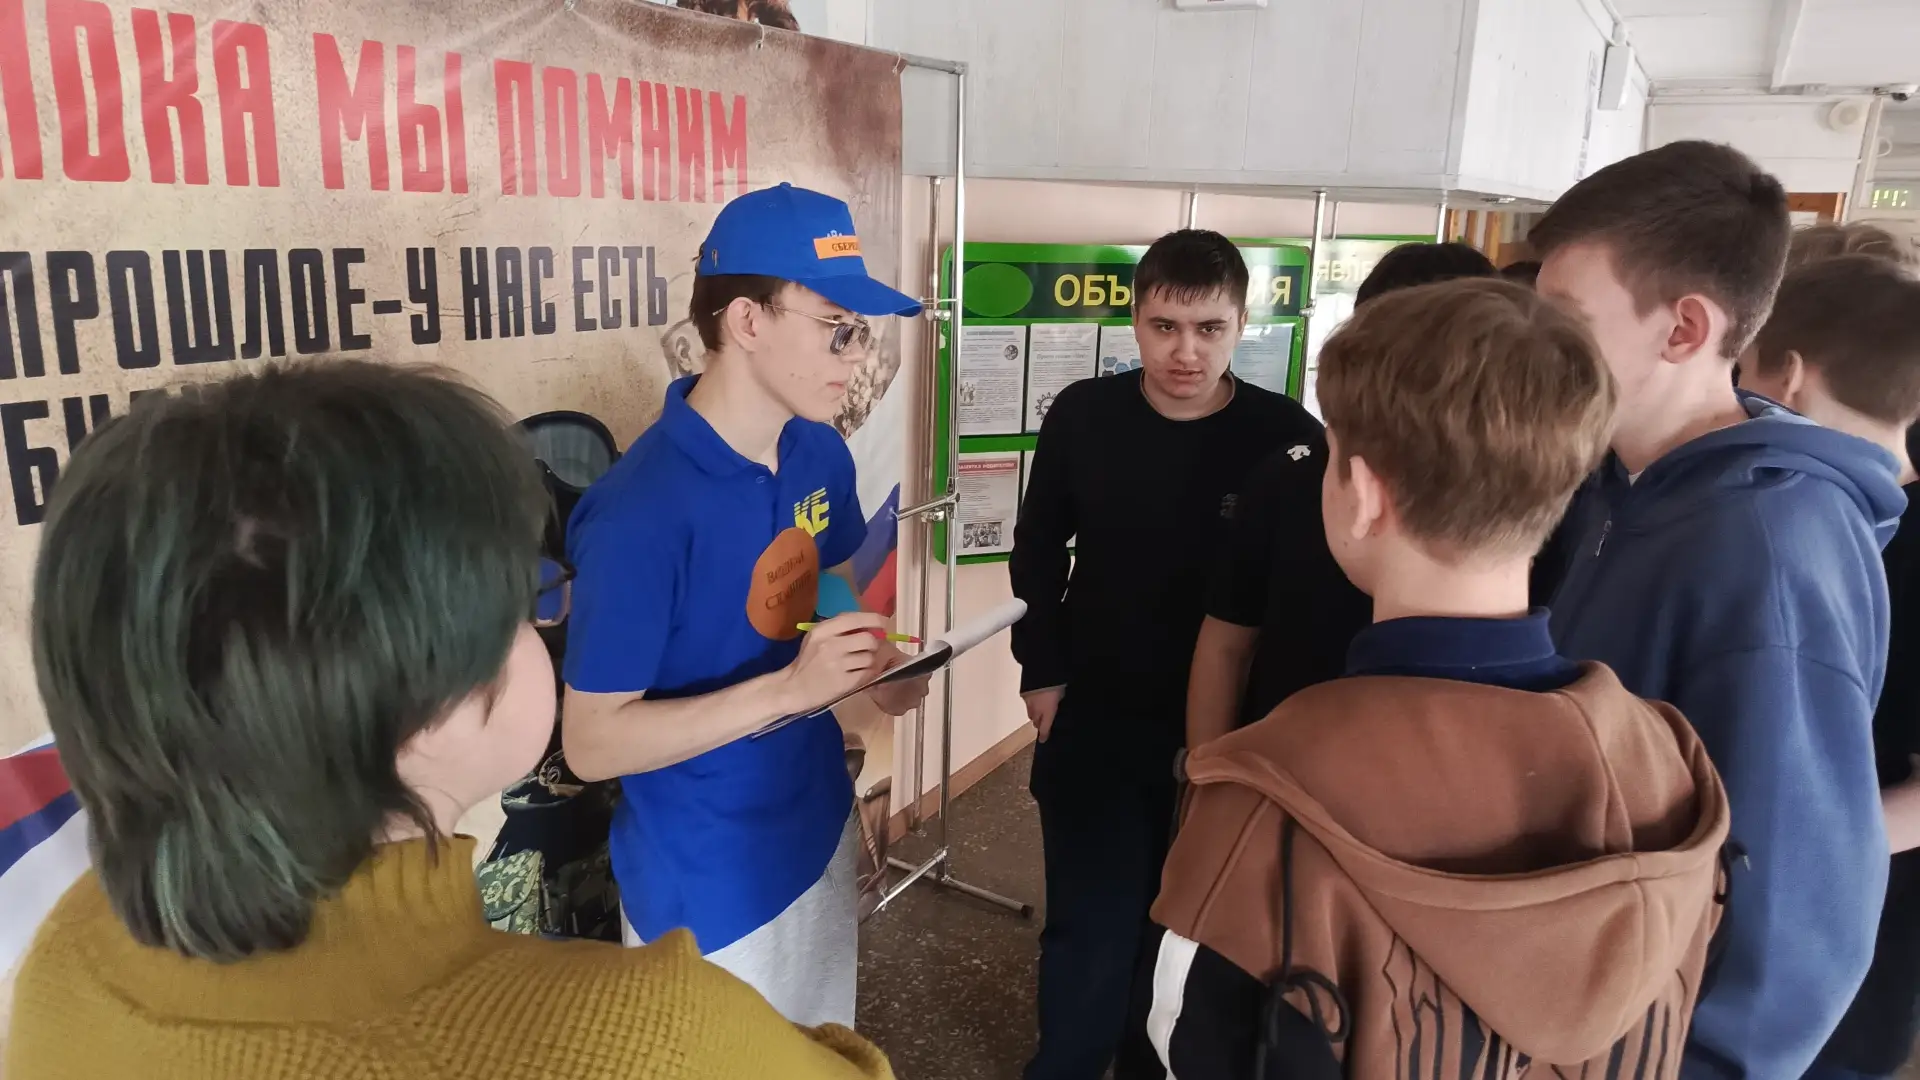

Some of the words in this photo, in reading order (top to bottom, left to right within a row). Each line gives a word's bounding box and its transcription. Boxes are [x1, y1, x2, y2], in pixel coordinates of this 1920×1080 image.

[313, 32, 469, 194] МЫ
[494, 58, 748, 204] ПОМНИМ
[460, 246, 557, 341] НАС
[572, 245, 668, 332] ЕСТЬ
